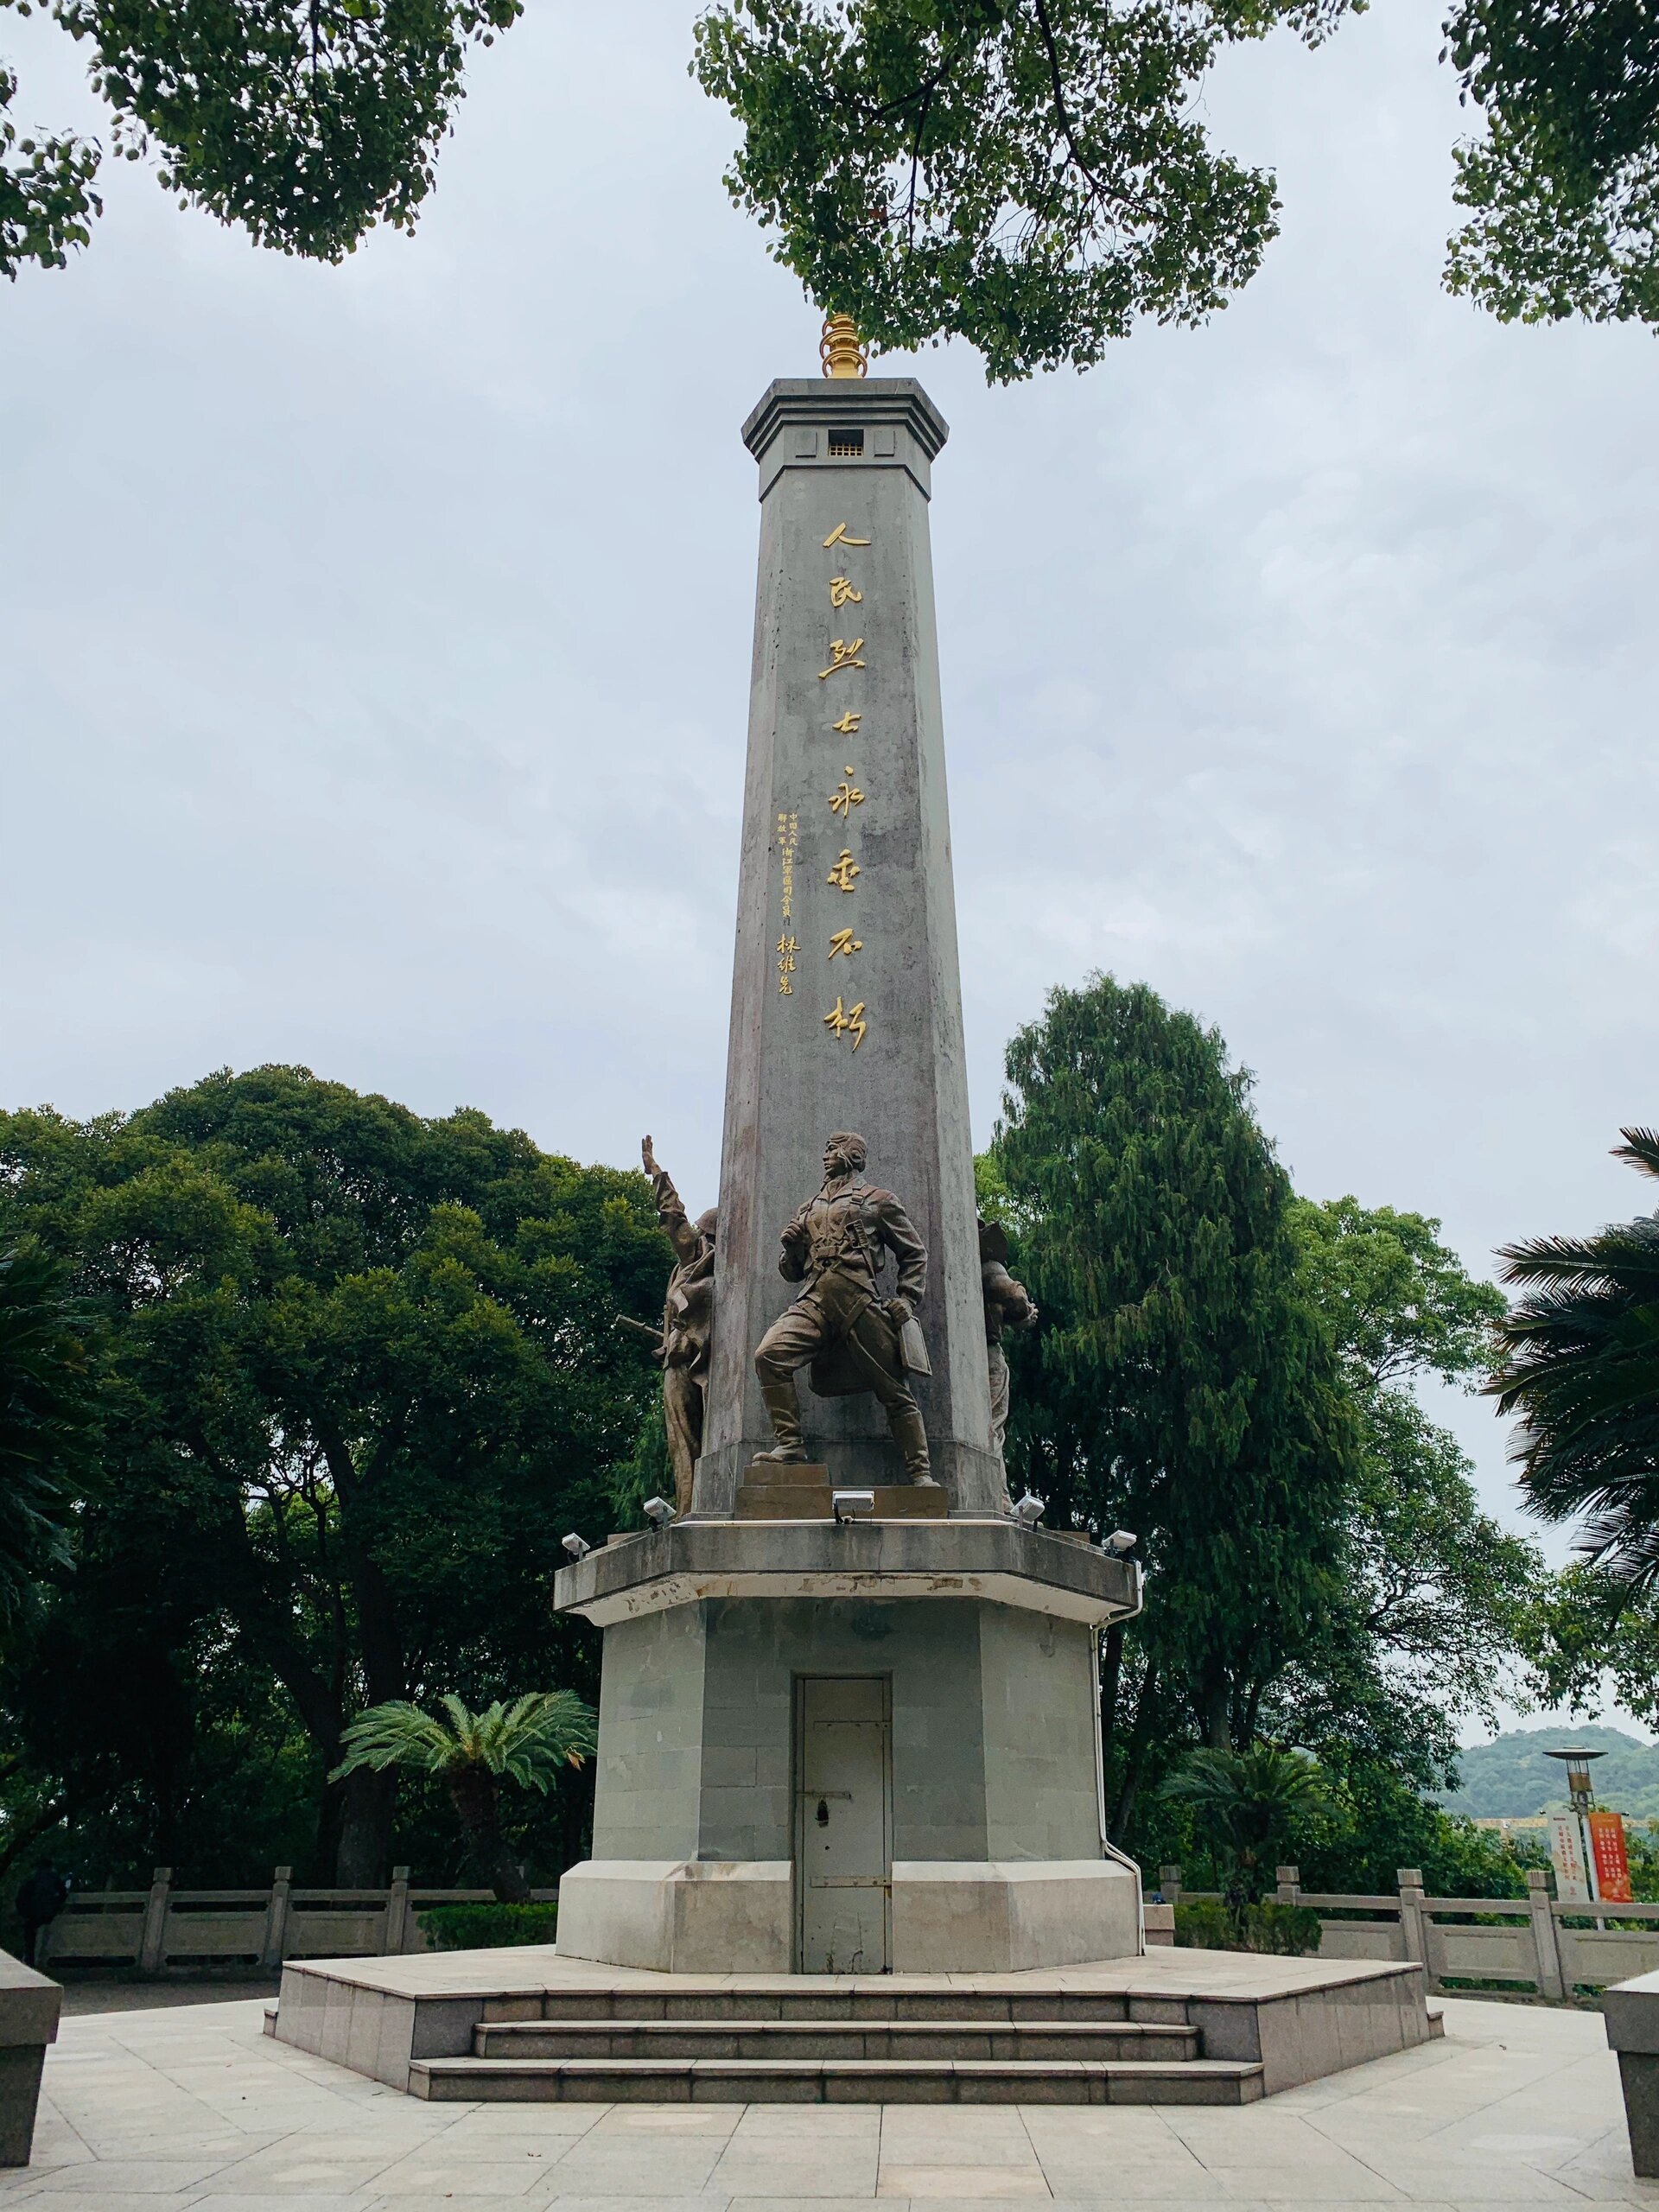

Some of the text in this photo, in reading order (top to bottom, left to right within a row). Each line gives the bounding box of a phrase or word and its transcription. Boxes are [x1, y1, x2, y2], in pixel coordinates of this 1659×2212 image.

[817, 522, 871, 1052] 人民烈士永垂不朽
